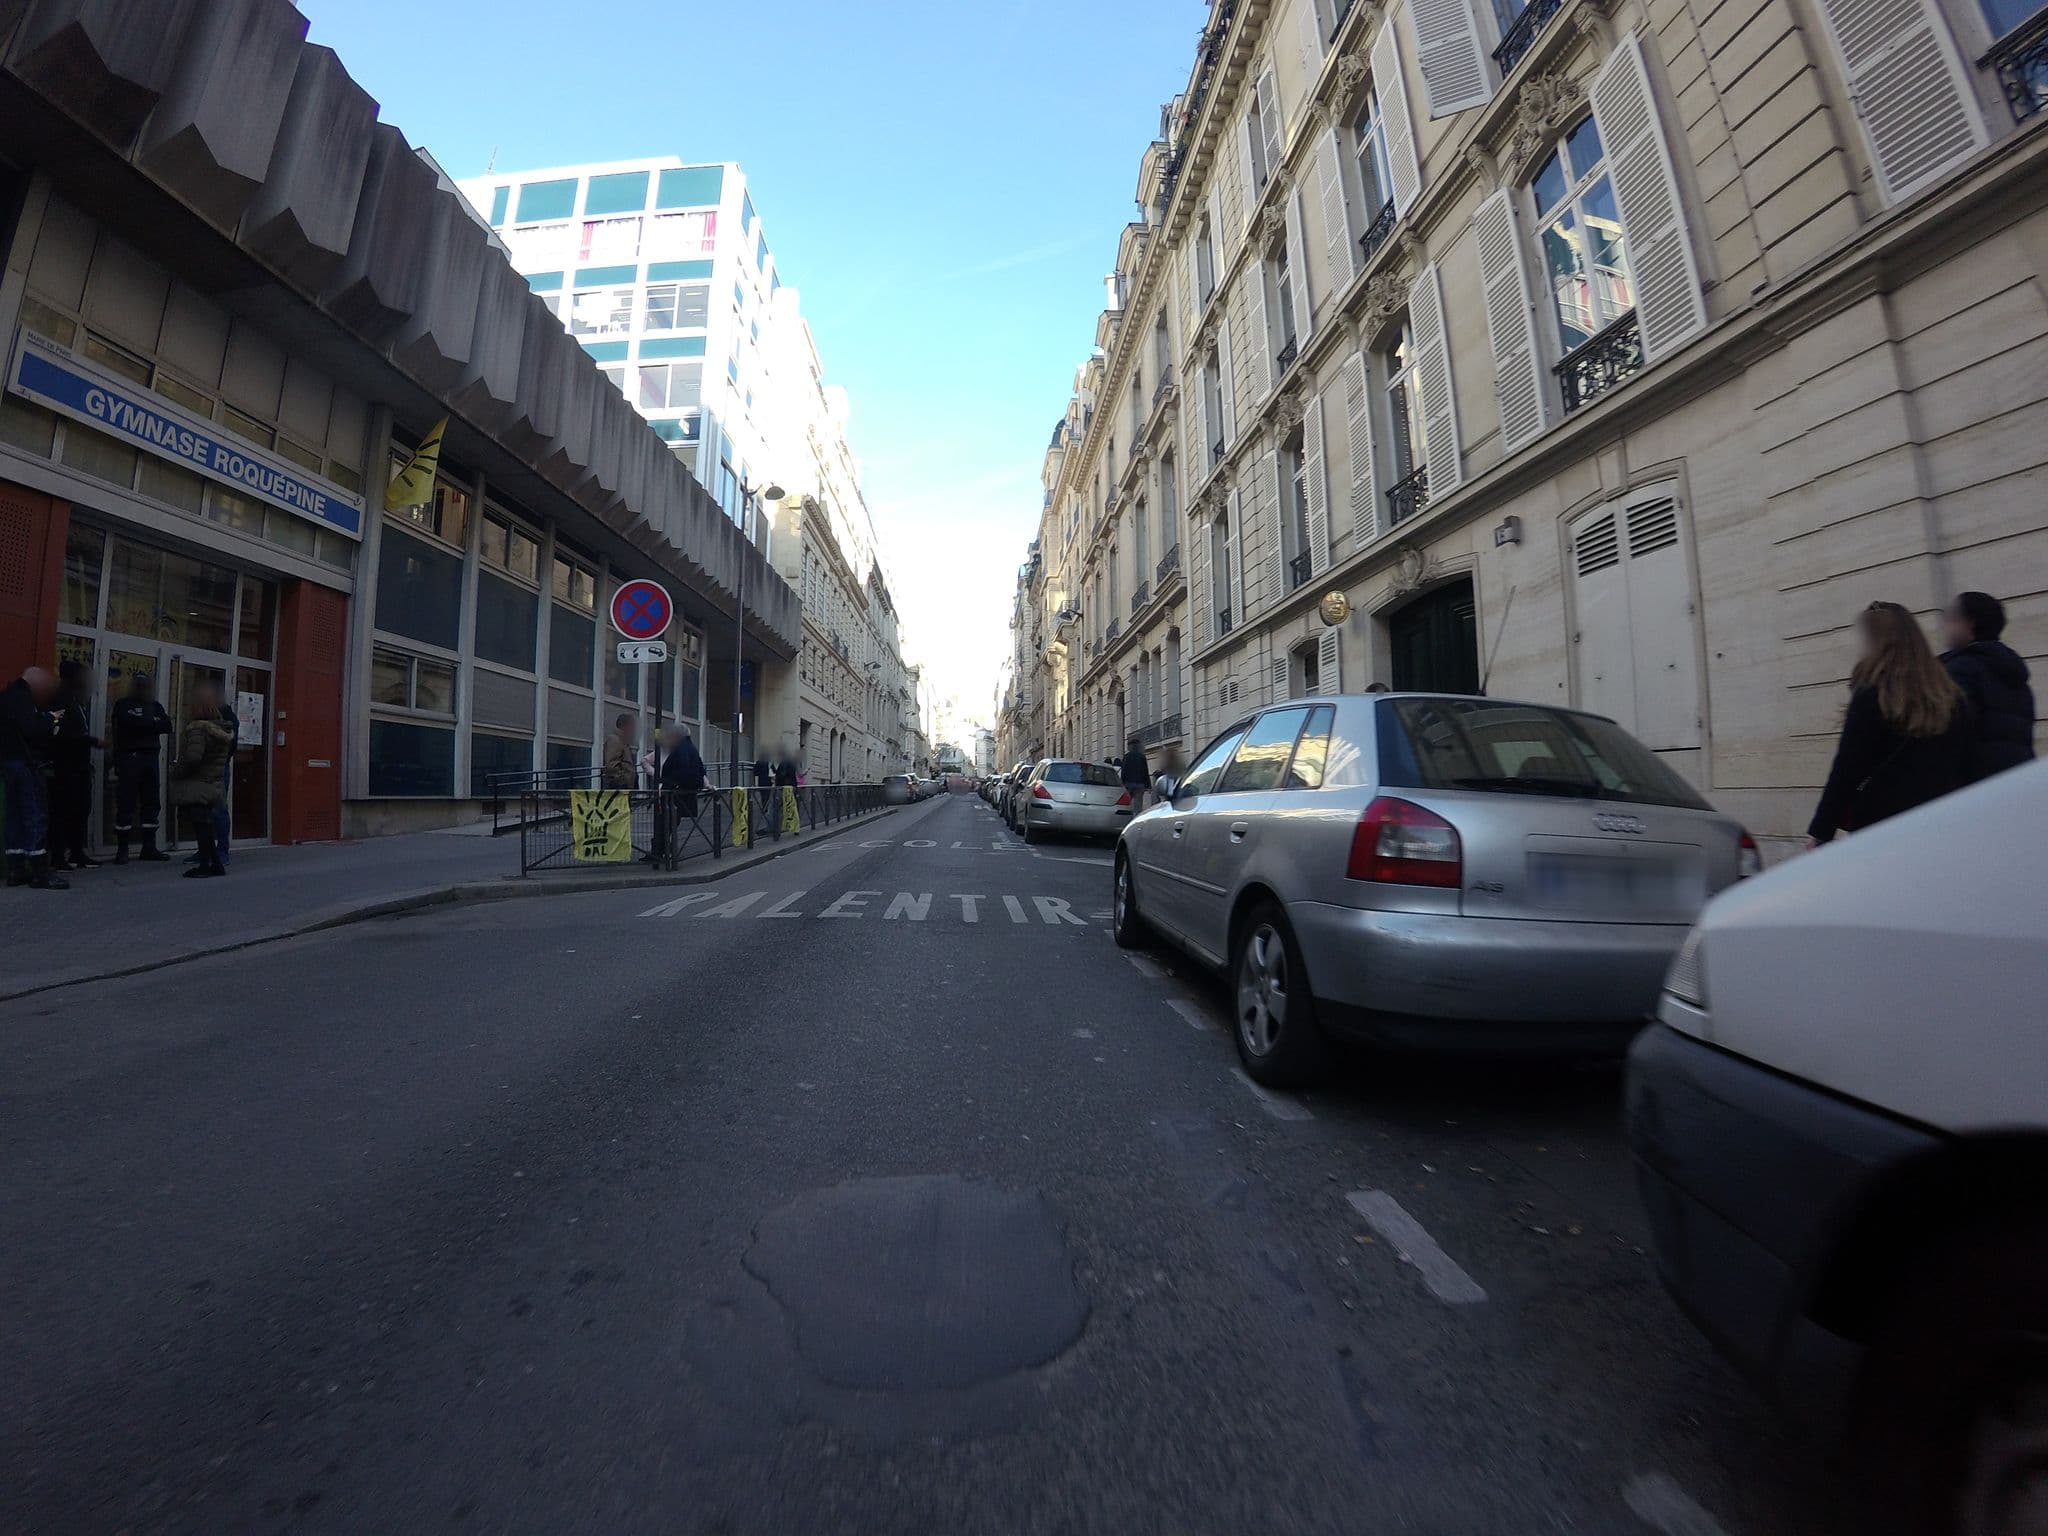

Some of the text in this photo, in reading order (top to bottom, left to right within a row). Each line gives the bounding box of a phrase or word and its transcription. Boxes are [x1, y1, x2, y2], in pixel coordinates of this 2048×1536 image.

[85, 388, 326, 517] GYMNASE ROQUÉPINE
[635, 890, 1089, 926] RALENTIR
